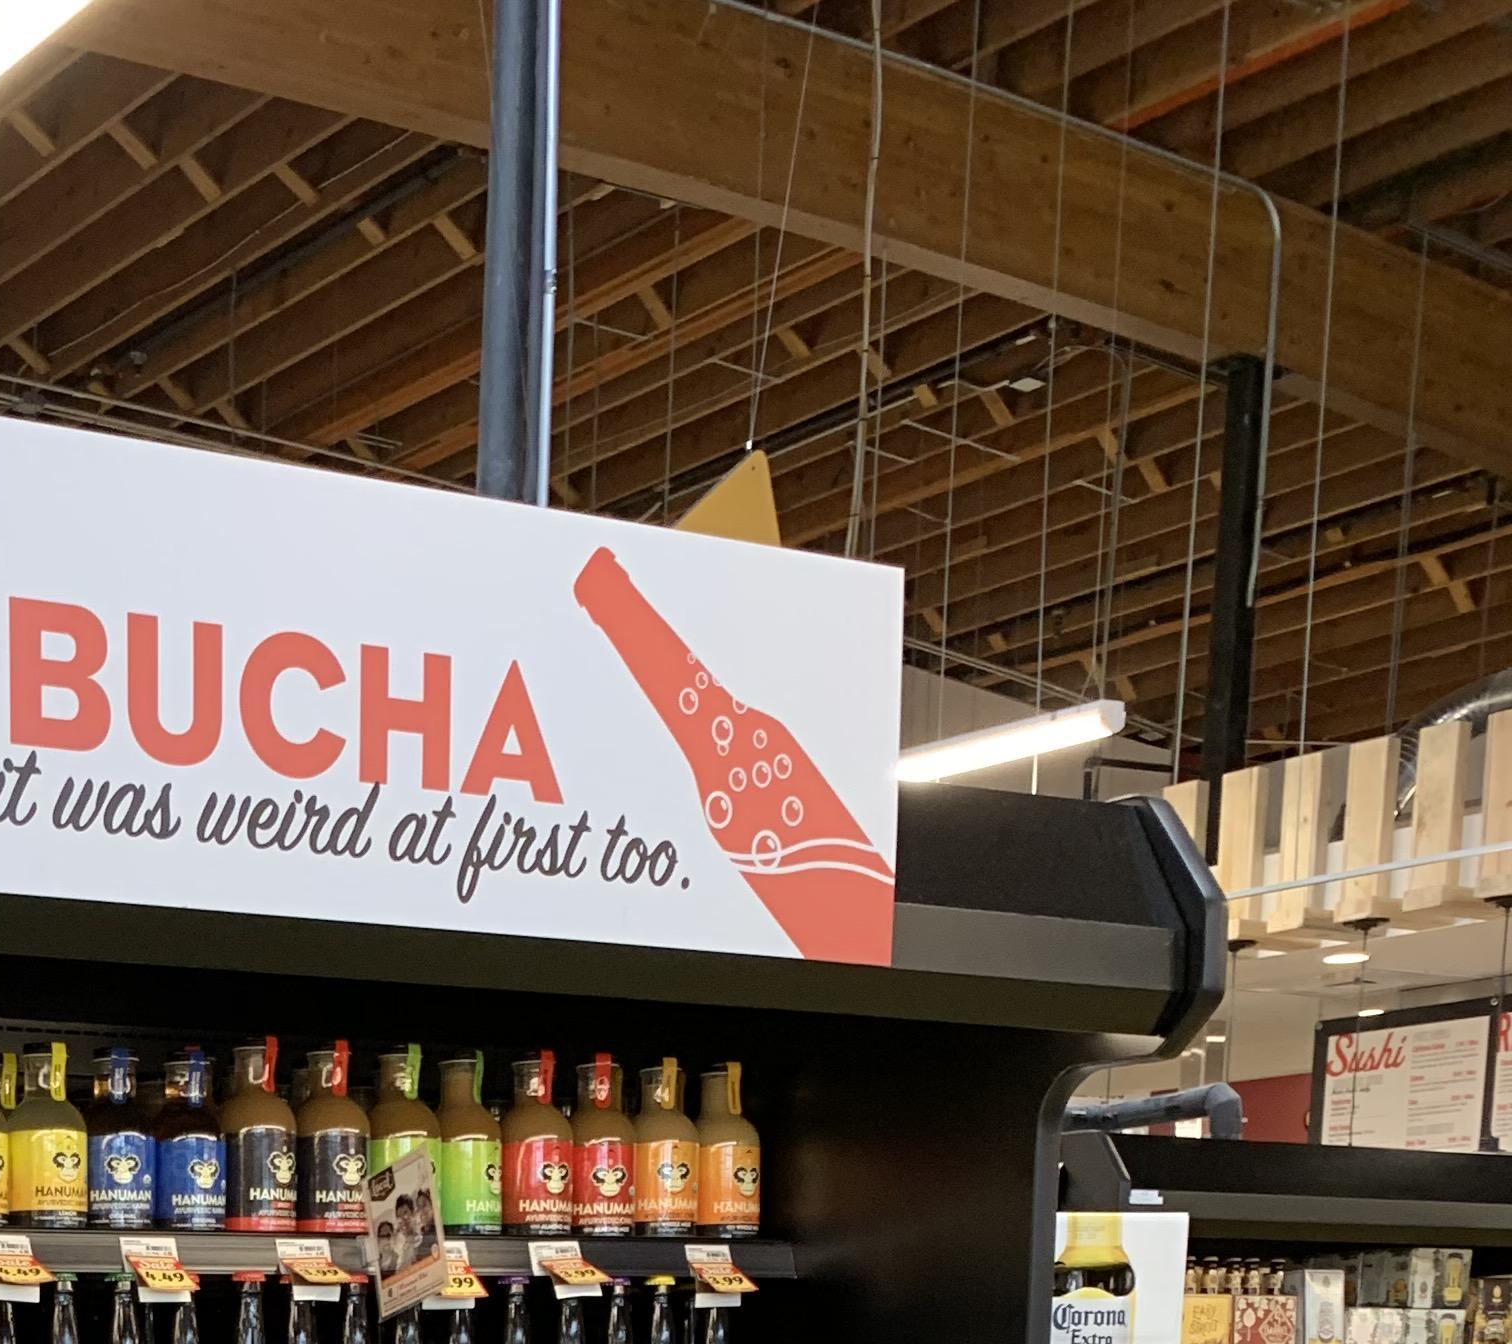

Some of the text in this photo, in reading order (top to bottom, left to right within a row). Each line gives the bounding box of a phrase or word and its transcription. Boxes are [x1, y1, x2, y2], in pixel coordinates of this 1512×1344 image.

[52, 775, 181, 841] was
[197, 781, 380, 858] weird
[388, 797, 458, 864] at
[457, 795, 592, 903] first
[599, 814, 690, 889] too.
[1326, 1032, 1406, 1076] Sushi
[91, 1190, 151, 1202] HANUMAN
[573, 1202, 635, 1215] HANUMAN
[1053, 1303, 1127, 1334] Corona
